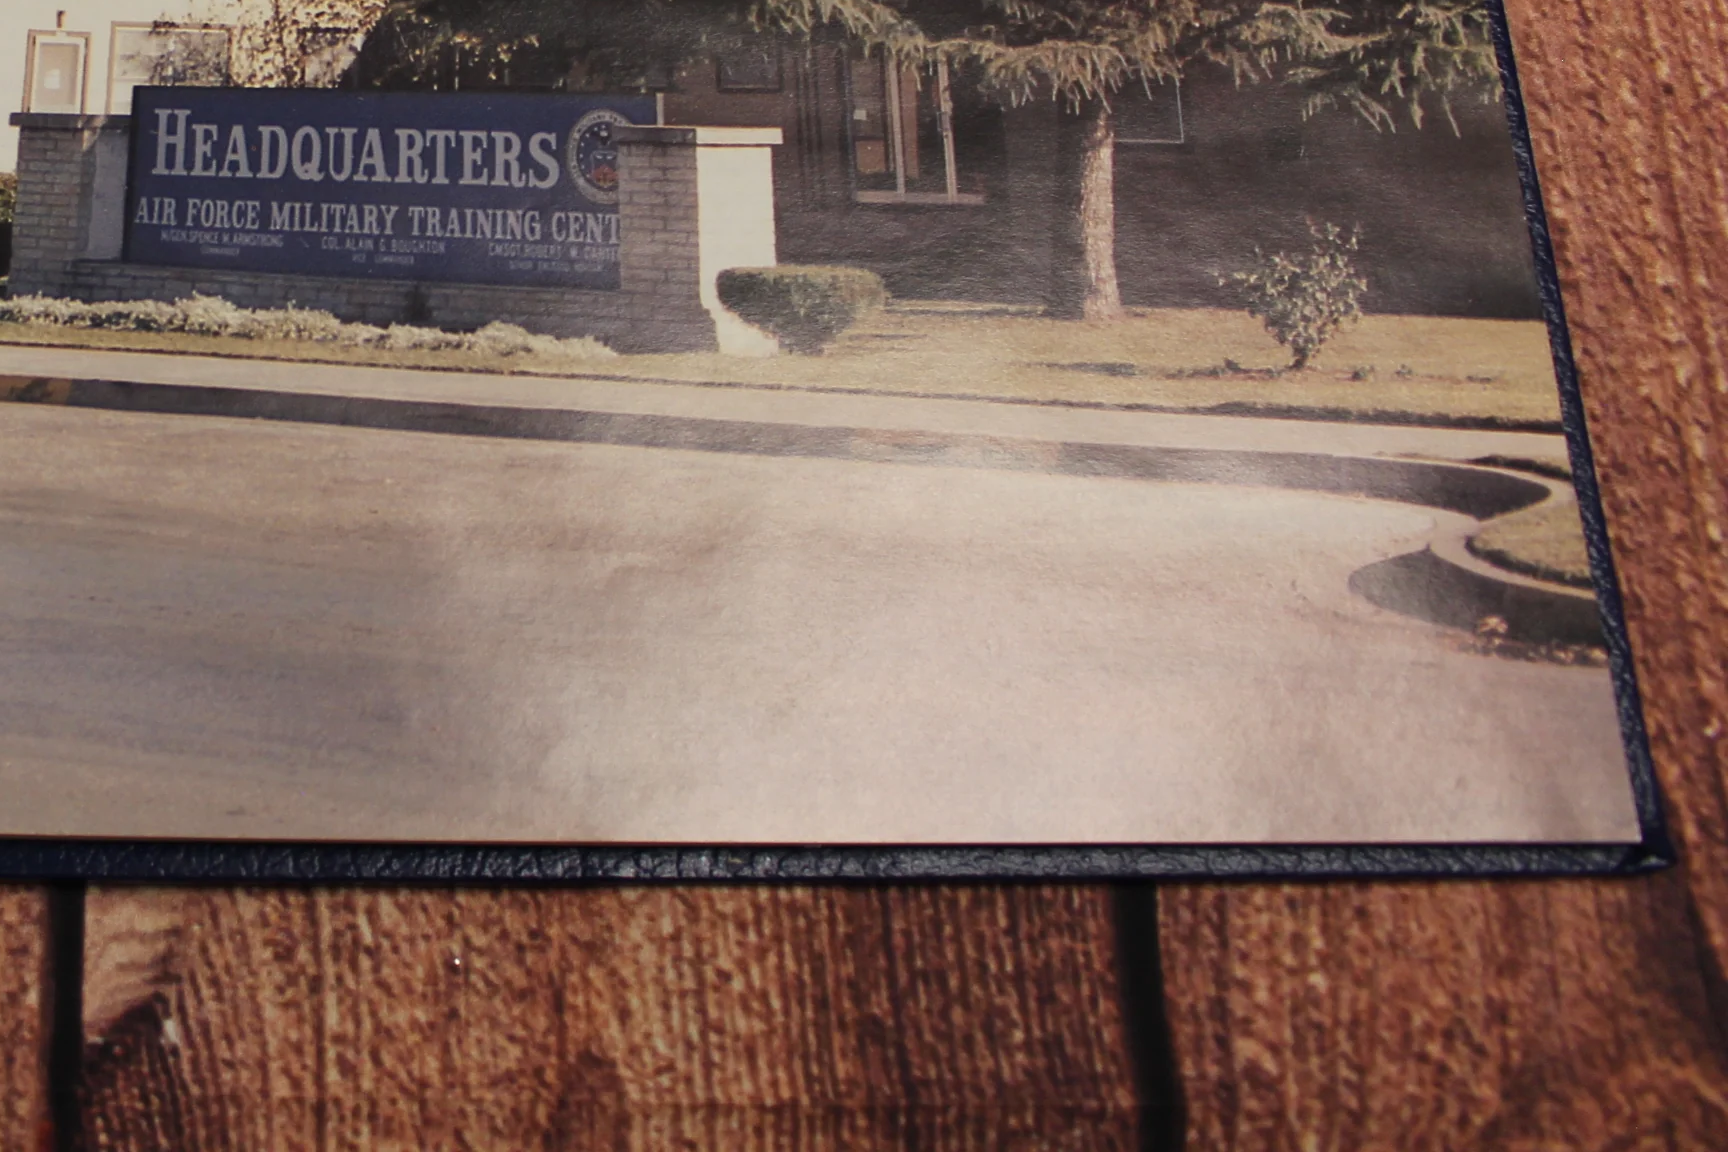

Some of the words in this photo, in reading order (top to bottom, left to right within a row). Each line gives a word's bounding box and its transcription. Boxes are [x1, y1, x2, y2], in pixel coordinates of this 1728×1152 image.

[152, 108, 560, 189] HEADQUARTERS
[134, 197, 177, 226] AIR
[185, 198, 261, 230] FORCE
[268, 201, 399, 236] MILITARY
[408, 206, 542, 242] TRAINING
